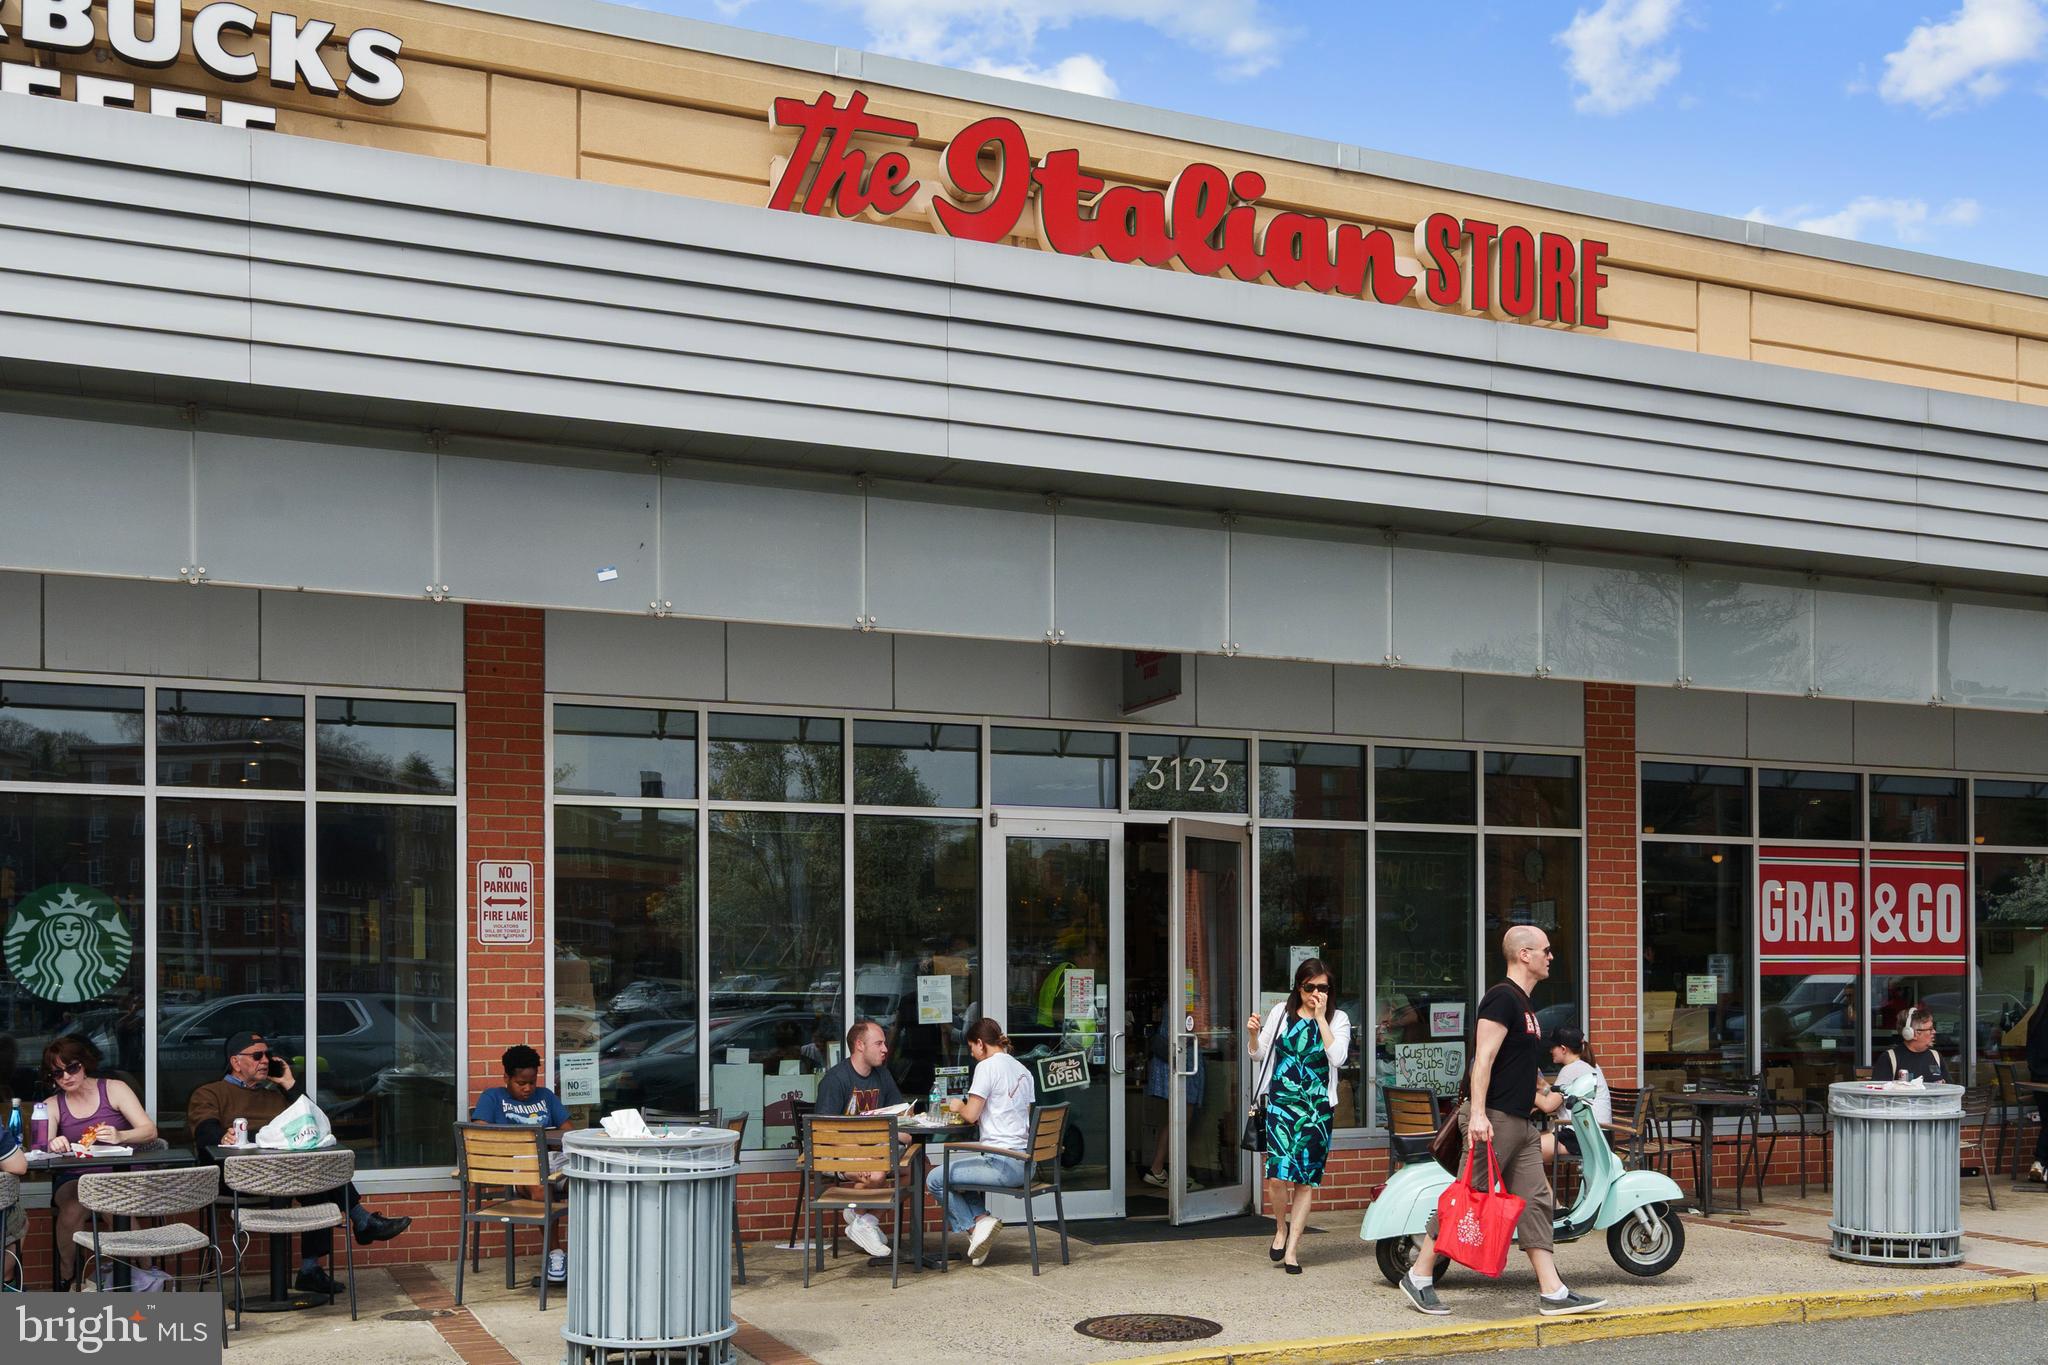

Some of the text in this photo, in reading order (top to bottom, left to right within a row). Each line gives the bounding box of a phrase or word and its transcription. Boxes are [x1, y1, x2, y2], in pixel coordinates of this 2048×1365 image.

[0, 0, 405, 107] BUCKS
[766, 89, 1611, 330] The Italian STORE
[1146, 754, 1231, 795] 3123
[498, 866, 513, 879] NO
[483, 880, 528, 893] PARKING
[483, 910, 529, 921] FIRE LANE
[1762, 879, 1855, 943] GRAB
[567, 1081, 579, 1089] NO
[1047, 1068, 1083, 1086] OPEN
